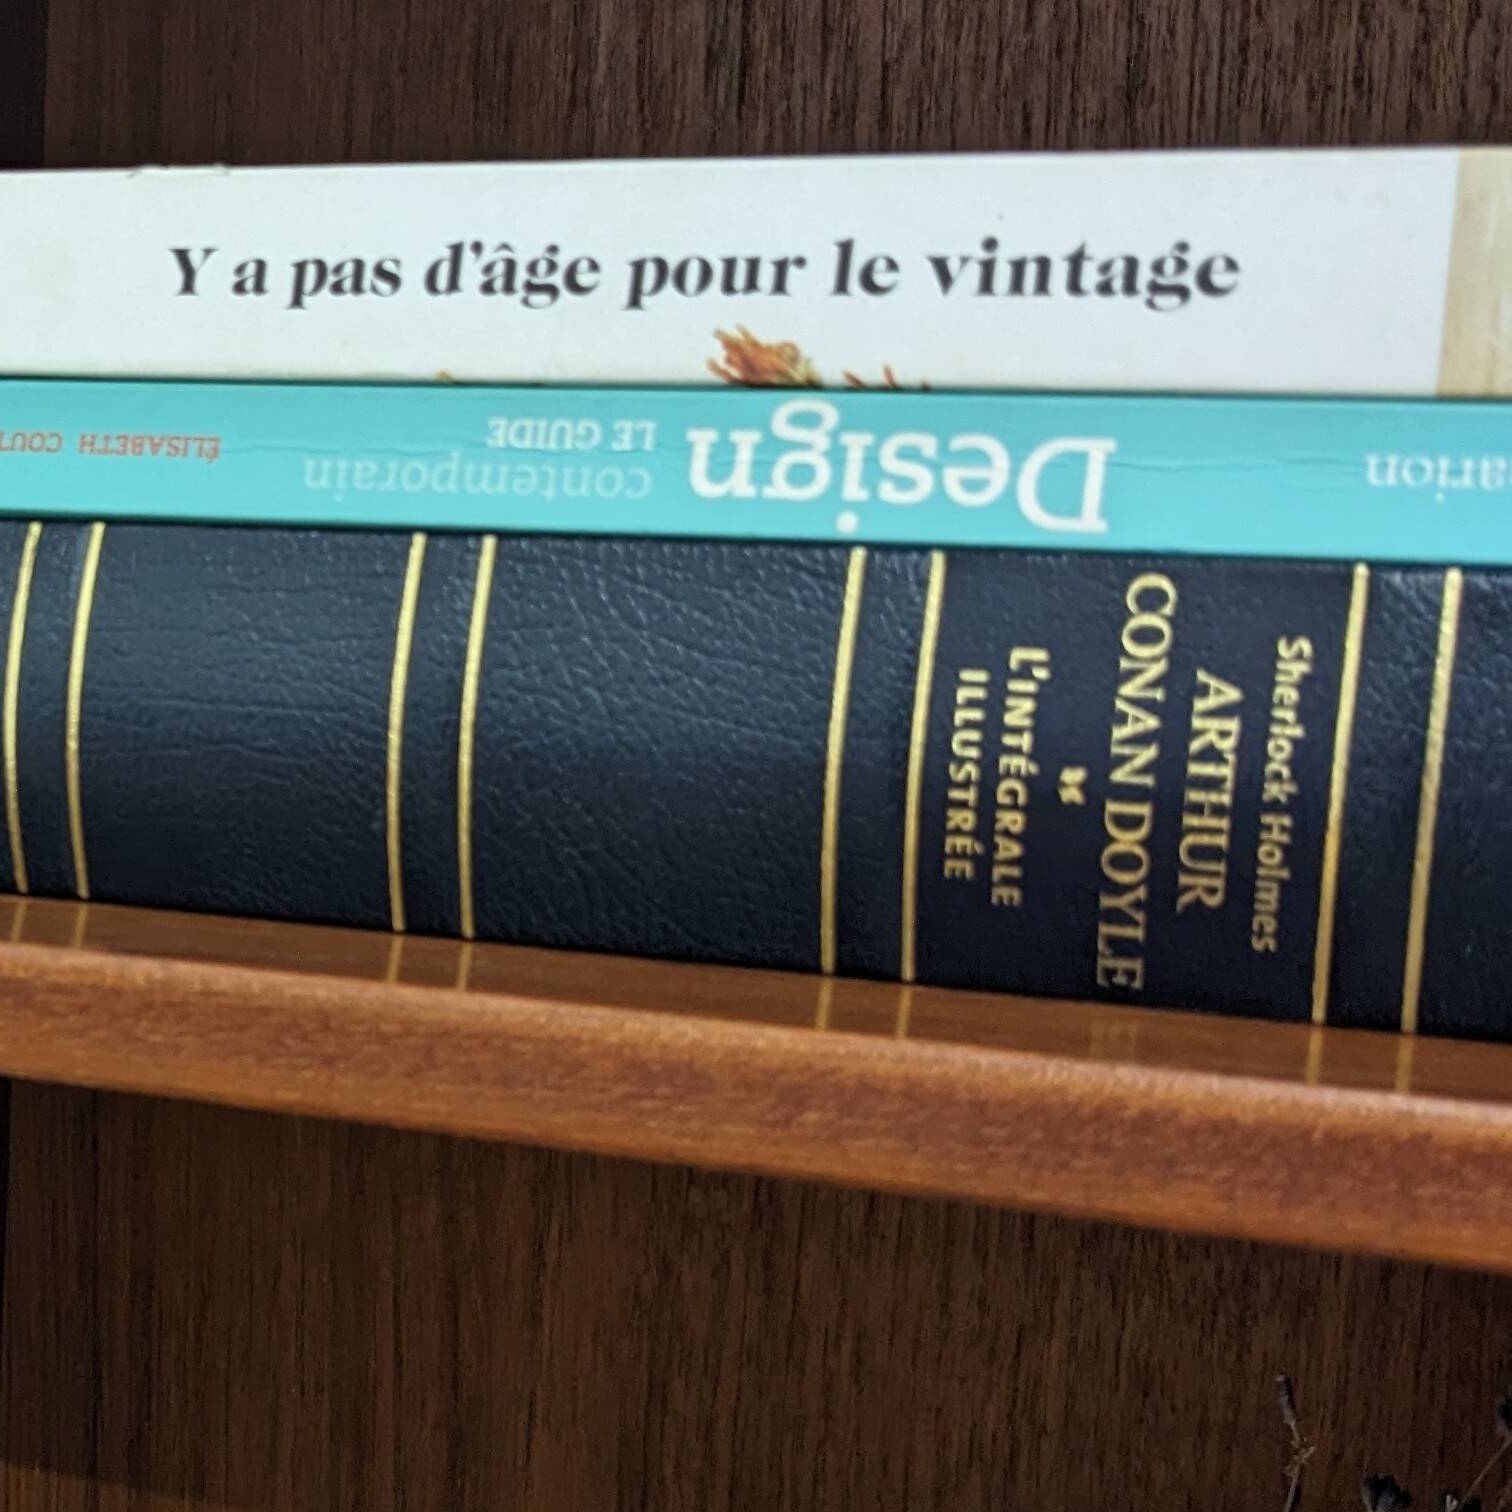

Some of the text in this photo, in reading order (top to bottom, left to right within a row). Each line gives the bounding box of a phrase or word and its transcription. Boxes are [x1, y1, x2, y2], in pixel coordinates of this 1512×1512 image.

[169, 235, 1241, 312] Y a pas d'âge pour le vintage
[78, 432, 221, 463] ÉLISABETH
[303, 450, 653, 502] contemporain
[486, 416, 657, 452] LE GUIDE
[685, 400, 1118, 537] Design
[1366, 454, 1512, 503] arion
[943, 668, 990, 881] ILLUSTRÉE
[990, 646, 1051, 908] L'INTÉGRALE
[1096, 572, 1178, 991] CONAN DOYLE
[1175, 668, 1244, 914] ARTHUR
[1251, 635, 1315, 953] Sherlock Holmes
